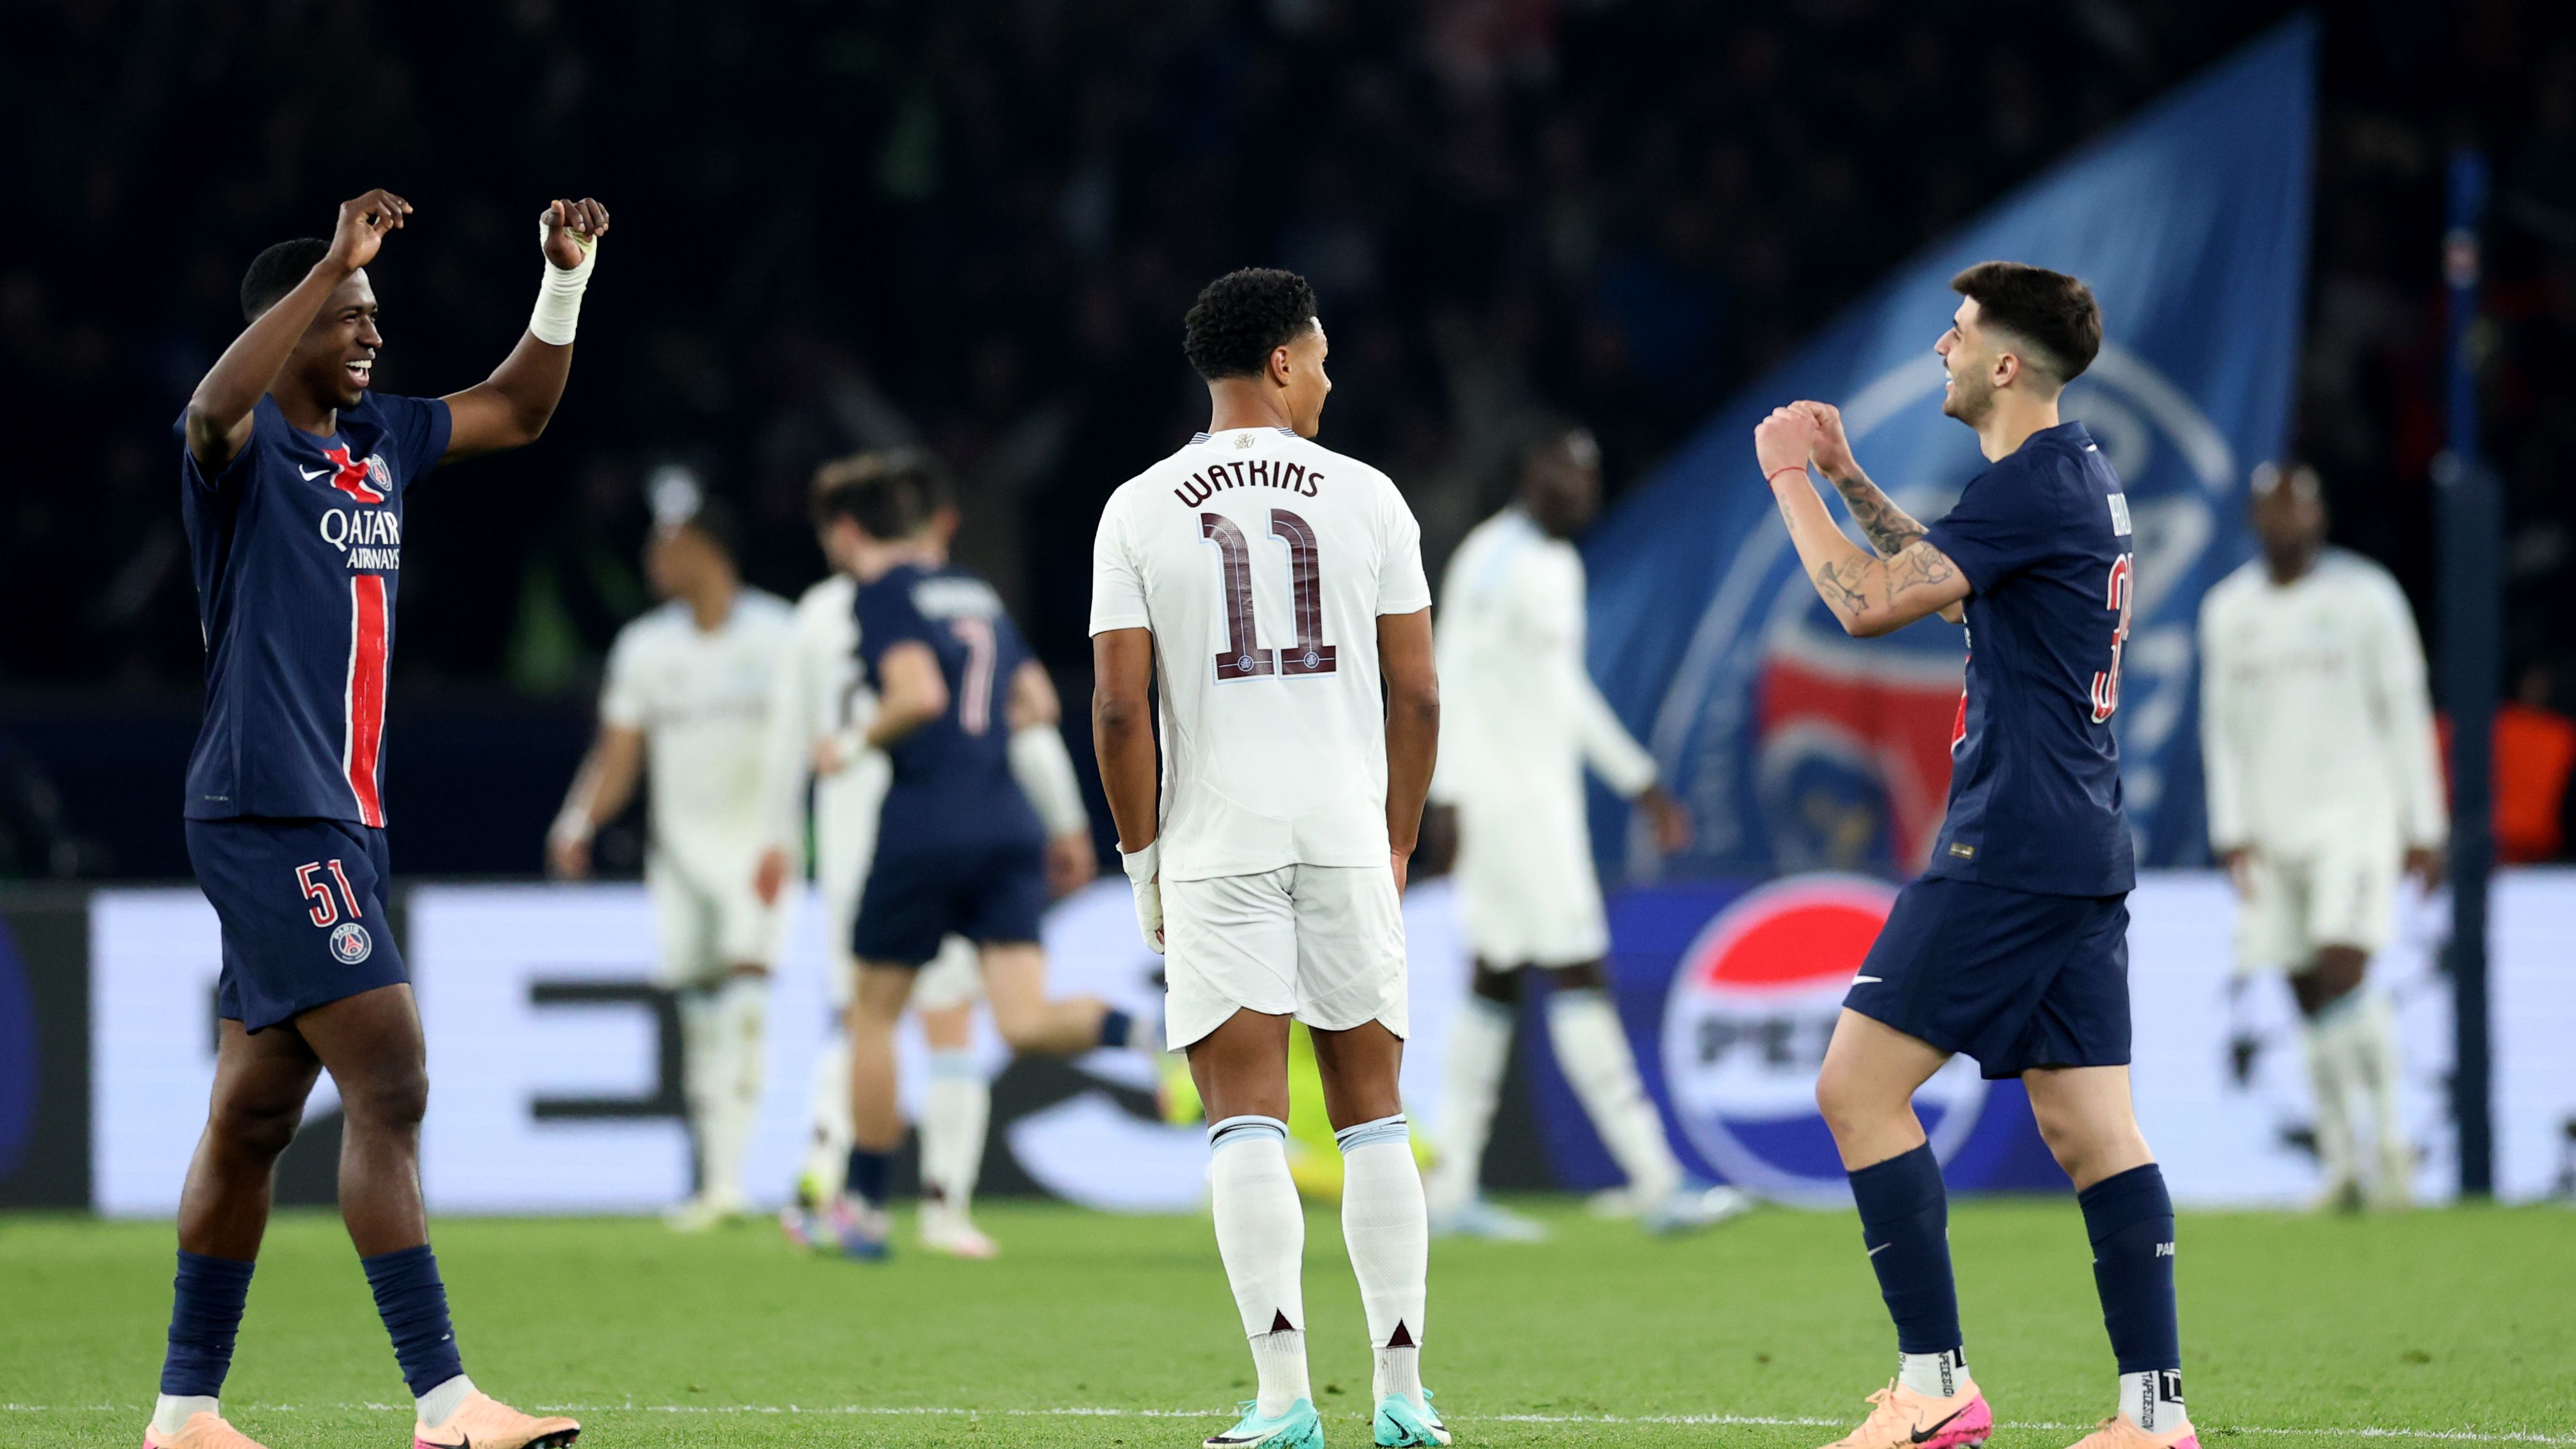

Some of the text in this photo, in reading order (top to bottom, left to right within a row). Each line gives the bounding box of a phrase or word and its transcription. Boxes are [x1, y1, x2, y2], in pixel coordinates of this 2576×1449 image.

[1174, 460, 1325, 508] WATKINS
[320, 508, 400, 553] QATAR
[346, 548, 400, 570] AIRWAYS
[1198, 508, 1336, 682] 11
[295, 859, 363, 928] 51
